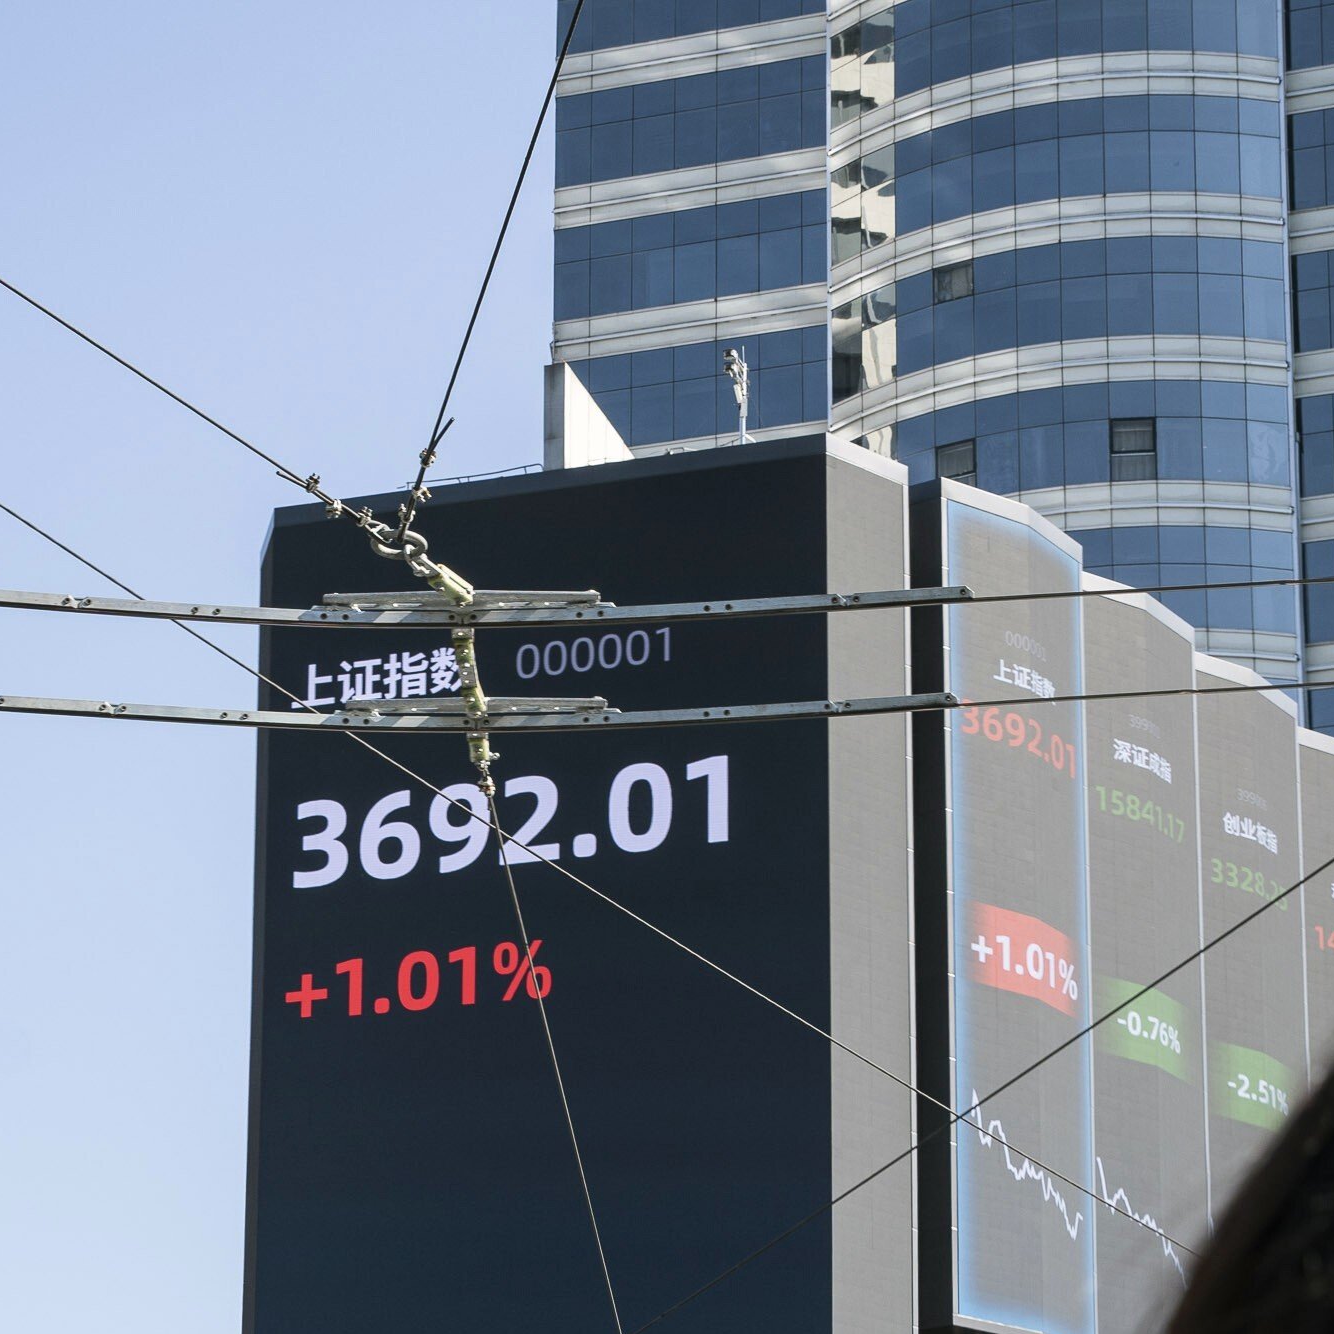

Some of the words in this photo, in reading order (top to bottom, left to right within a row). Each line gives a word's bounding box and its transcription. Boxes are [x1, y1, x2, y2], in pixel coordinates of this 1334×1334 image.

[515, 627, 673, 680] 000001
[993, 659, 1057, 706] 上证指数
[961, 698, 1077, 779] 3692.01
[1113, 738, 1172, 784] 深证成指
[292, 754, 731, 890] 3692.01
[1095, 785, 1185, 843] 15841.17
[1223, 812, 1278, 854] 创业板指
[285, 938, 553, 1019] +1.01%
[971, 935, 1078, 1001] +1.01%
[1117, 1010, 1181, 1054] -0.76%
[1227, 1073, 1289, 1117] -2.51%
